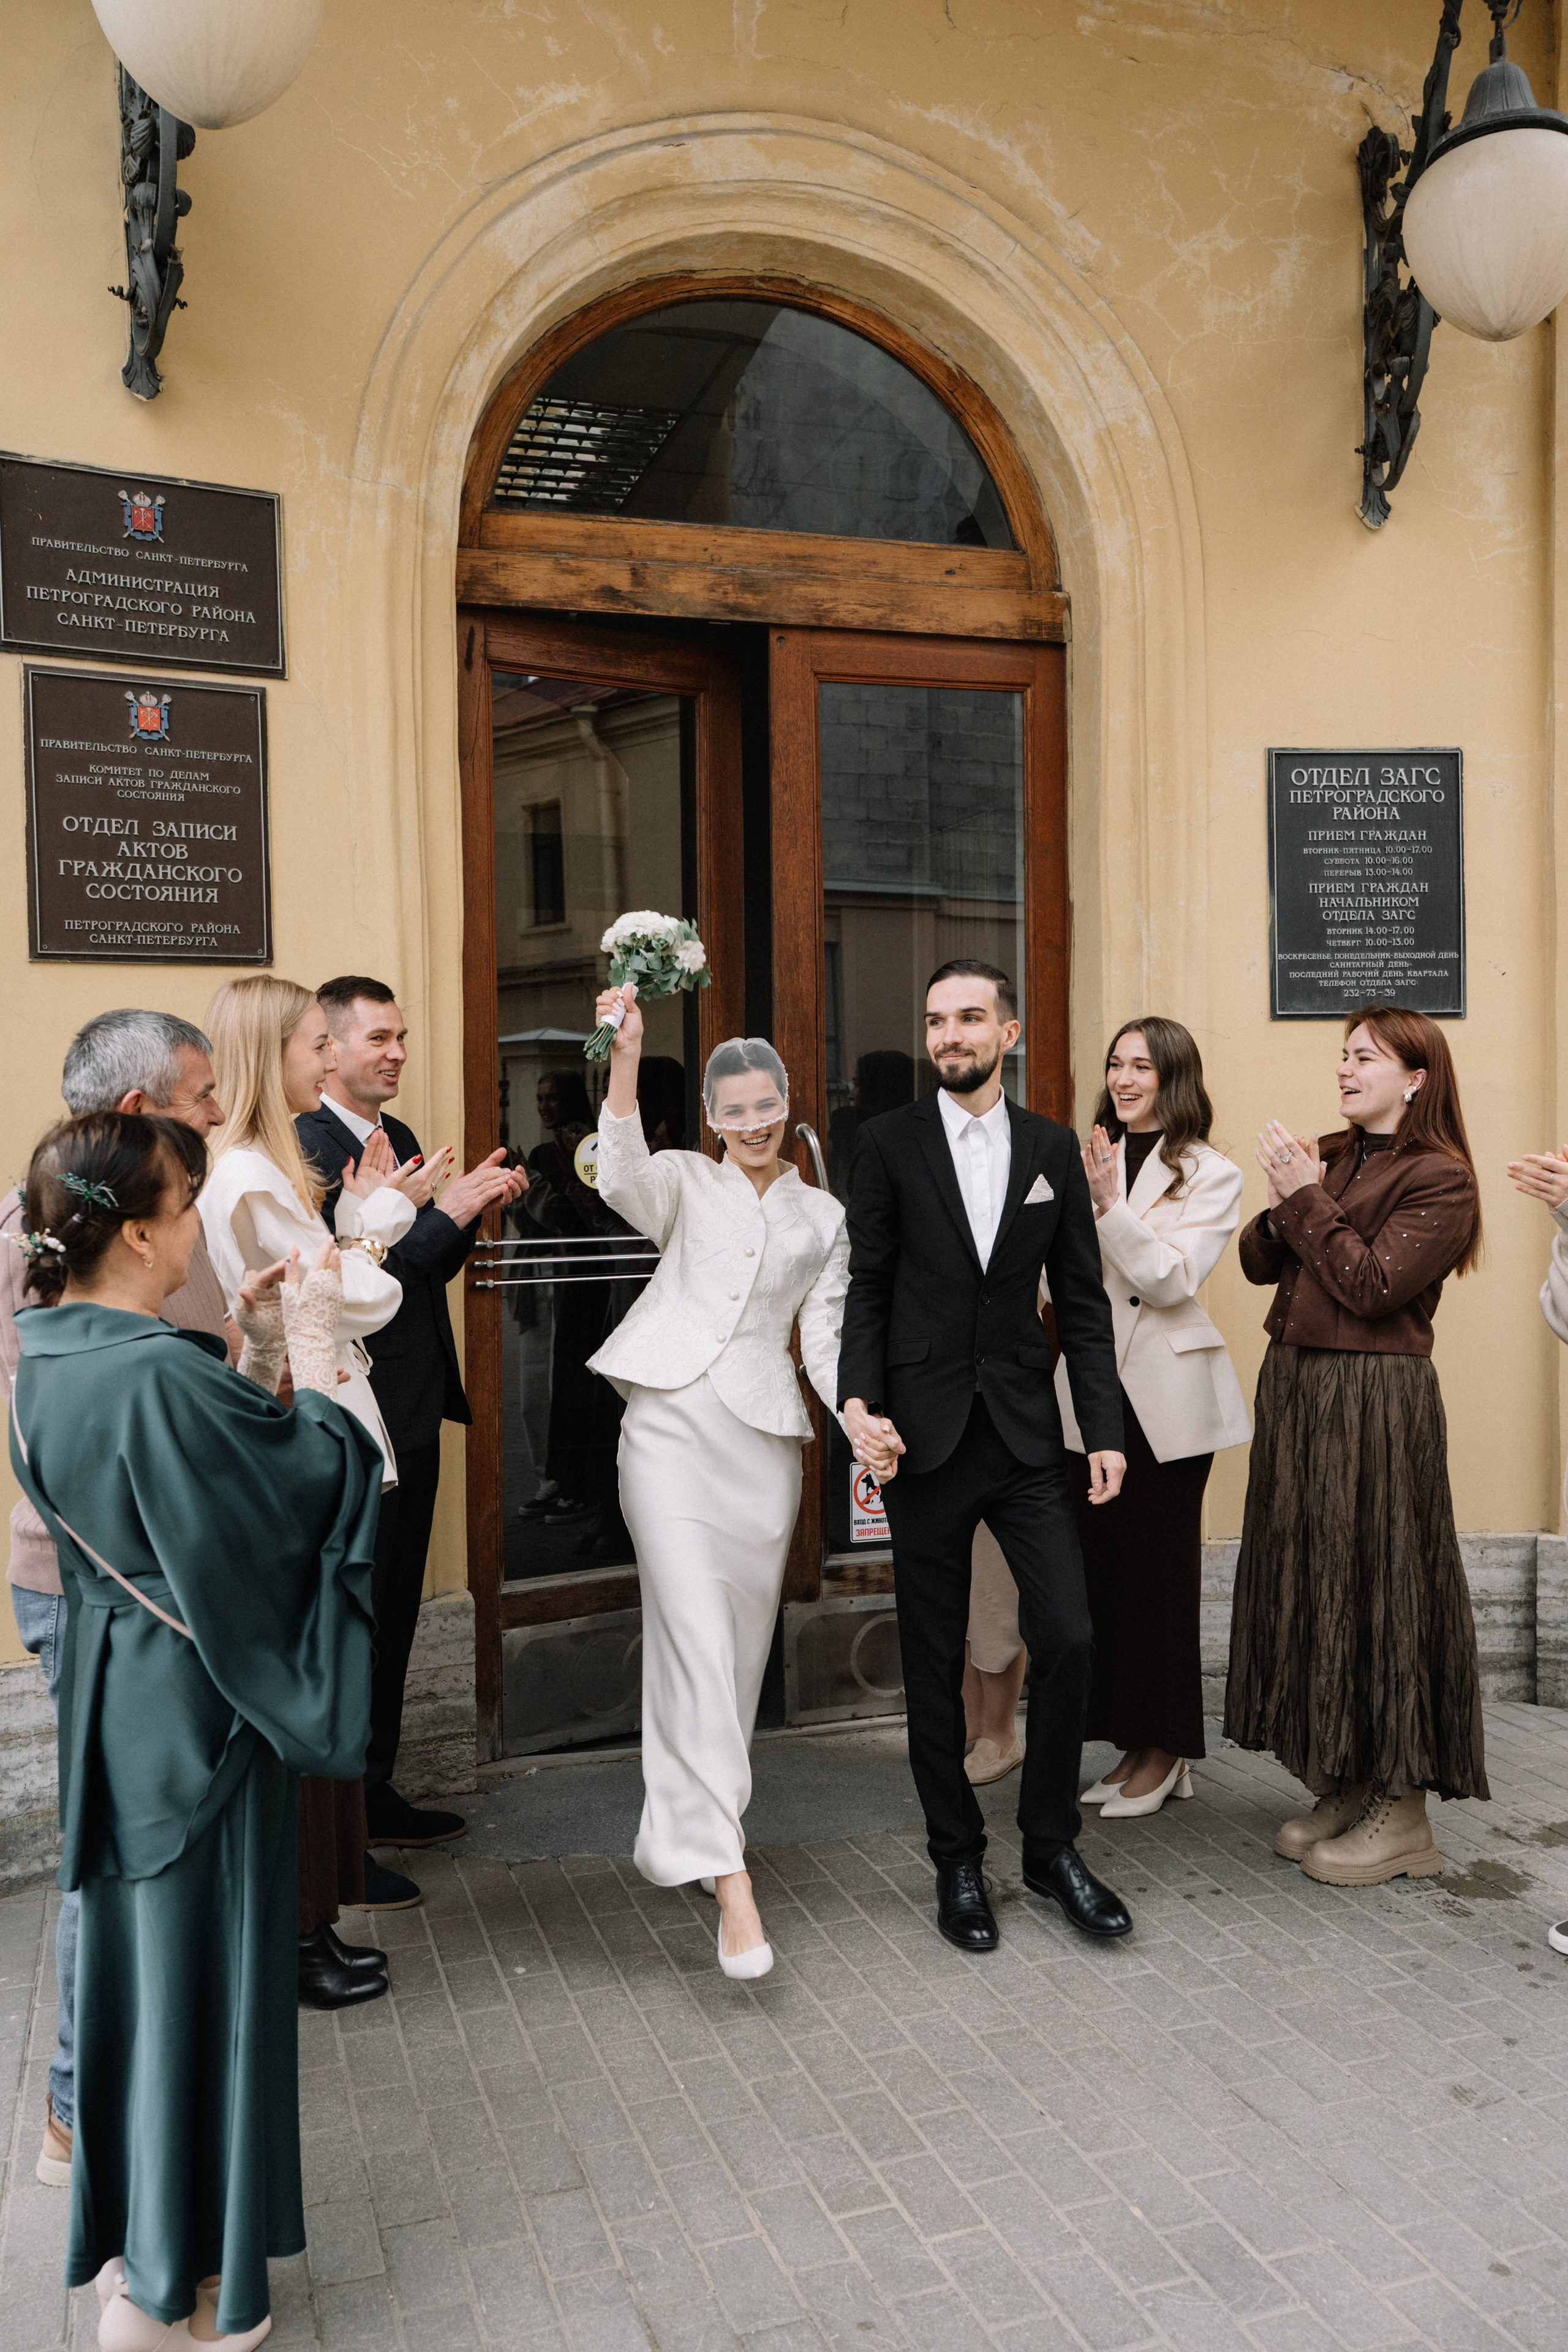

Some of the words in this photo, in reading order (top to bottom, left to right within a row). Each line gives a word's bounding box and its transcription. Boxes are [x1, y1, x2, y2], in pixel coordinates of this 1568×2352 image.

[32, 537, 129, 557] ПРАВИТЕЛЬСТВО
[136, 551, 248, 572] САНКТ-ПЕТЕРБУРГА
[66, 569, 219, 598] АДМИНИСТРАЦИЯ
[26, 586, 183, 615] ПЕТРОГРАДСКОГО
[192, 605, 256, 624] РАЙОНА
[58, 613, 229, 643] САНКТ-ПЕТЕРБУРГА
[40, 739, 137, 754] ПРАВИТЕЛЬСТВО
[145, 747, 252, 763] САНКТ-ПЕТЕРБУРГА
[89, 764, 142, 776] КОМИТЕТ
[149, 769, 164, 778] ПО
[170, 771, 209, 781] ДЕЛАМ
[1291, 768, 1370, 788] ОТДЕЛ
[1380, 768, 1441, 786] ЗАГС
[56, 775, 102, 785] ЗАПИСИ
[108, 778, 145, 788] АКТОВ
[151, 780, 241, 794] ГРАЖДАНСКОГО
[117, 790, 184, 802] СОСТОЯНИЯ
[1289, 790, 1444, 805] ПЕТРОГРАДСКОГО
[1333, 804, 1400, 820] РАЙОНА
[62, 816, 138, 837] ОТДЕЛ
[153, 821, 237, 841] ЗАПИСИ
[1308, 831, 1355, 841] ПРИЕМ
[1360, 830, 1427, 842] ГРАЖДАН
[118, 842, 188, 859] АКТОВ
[59, 860, 243, 883] ГРАЖДАНСКОГО
[86, 883, 218, 903] СОСТОЯНИЯ
[1308, 883, 1355, 893] ПРИЕМ
[1361, 883, 1428, 894] ГРАЖДАН
[1319, 897, 1419, 908] НАЧАЛЬНИКОМ
[1322, 911, 1375, 922] ОТДЕЛА
[1381, 910, 1415, 920] ЗАГС
[64, 920, 183, 933] ПЕТРОГРАДСКОГО
[191, 921, 241, 934] РАЙОНА
[89, 934, 218, 946] САНКТ-ПЕТЕРБУРГА
